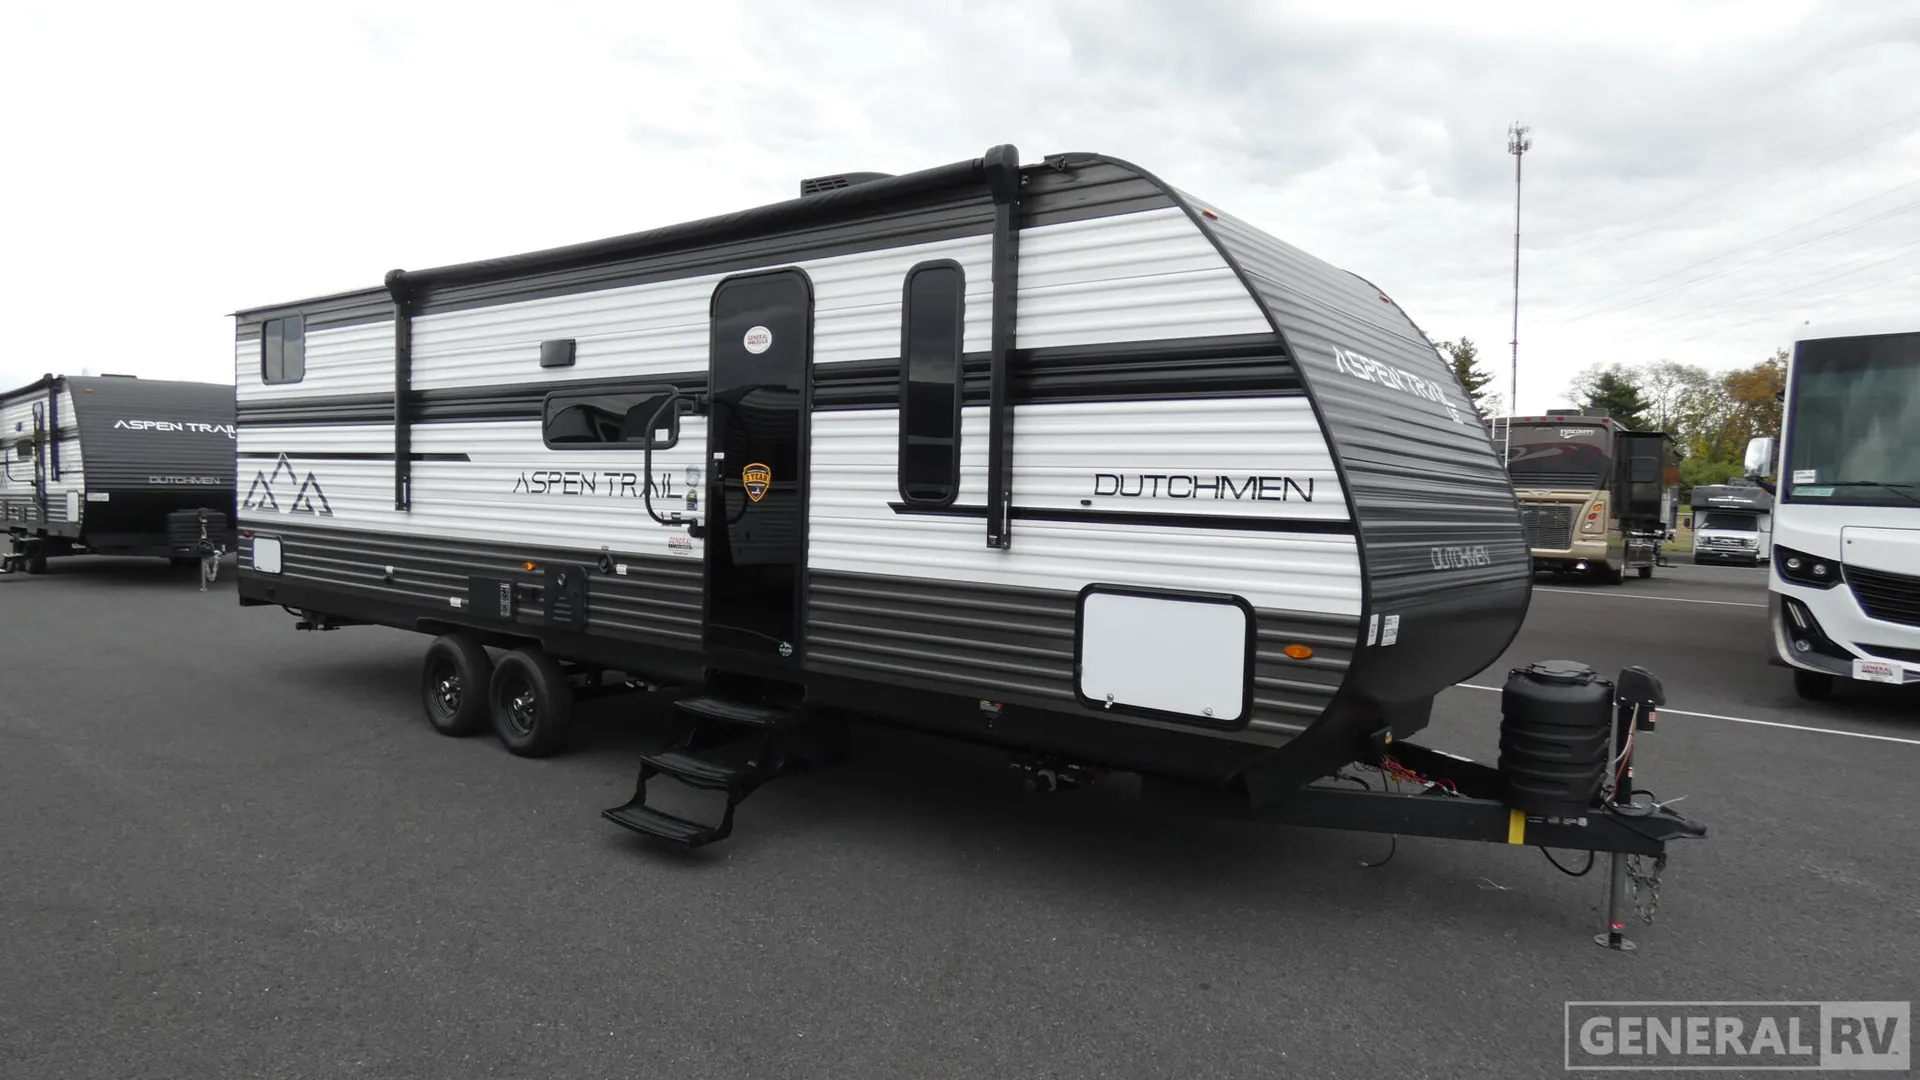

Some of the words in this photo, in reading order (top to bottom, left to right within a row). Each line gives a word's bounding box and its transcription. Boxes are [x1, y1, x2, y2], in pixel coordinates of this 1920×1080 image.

[1332, 345, 1407, 392] ASPEN
[1397, 369, 1456, 409] TRAIL
[114, 420, 183, 431] ASPEN
[185, 422, 236, 433] TRAIL
[149, 476, 221, 484] DUTCHMEN
[513, 472, 596, 496] ASPEN
[604, 472, 682, 498] TRAIL
[1095, 473, 1314, 502] DUTCHMEN
[1431, 545, 1491, 570] DUTCHMEN
[1861, 664, 1892, 672] GENERAL
